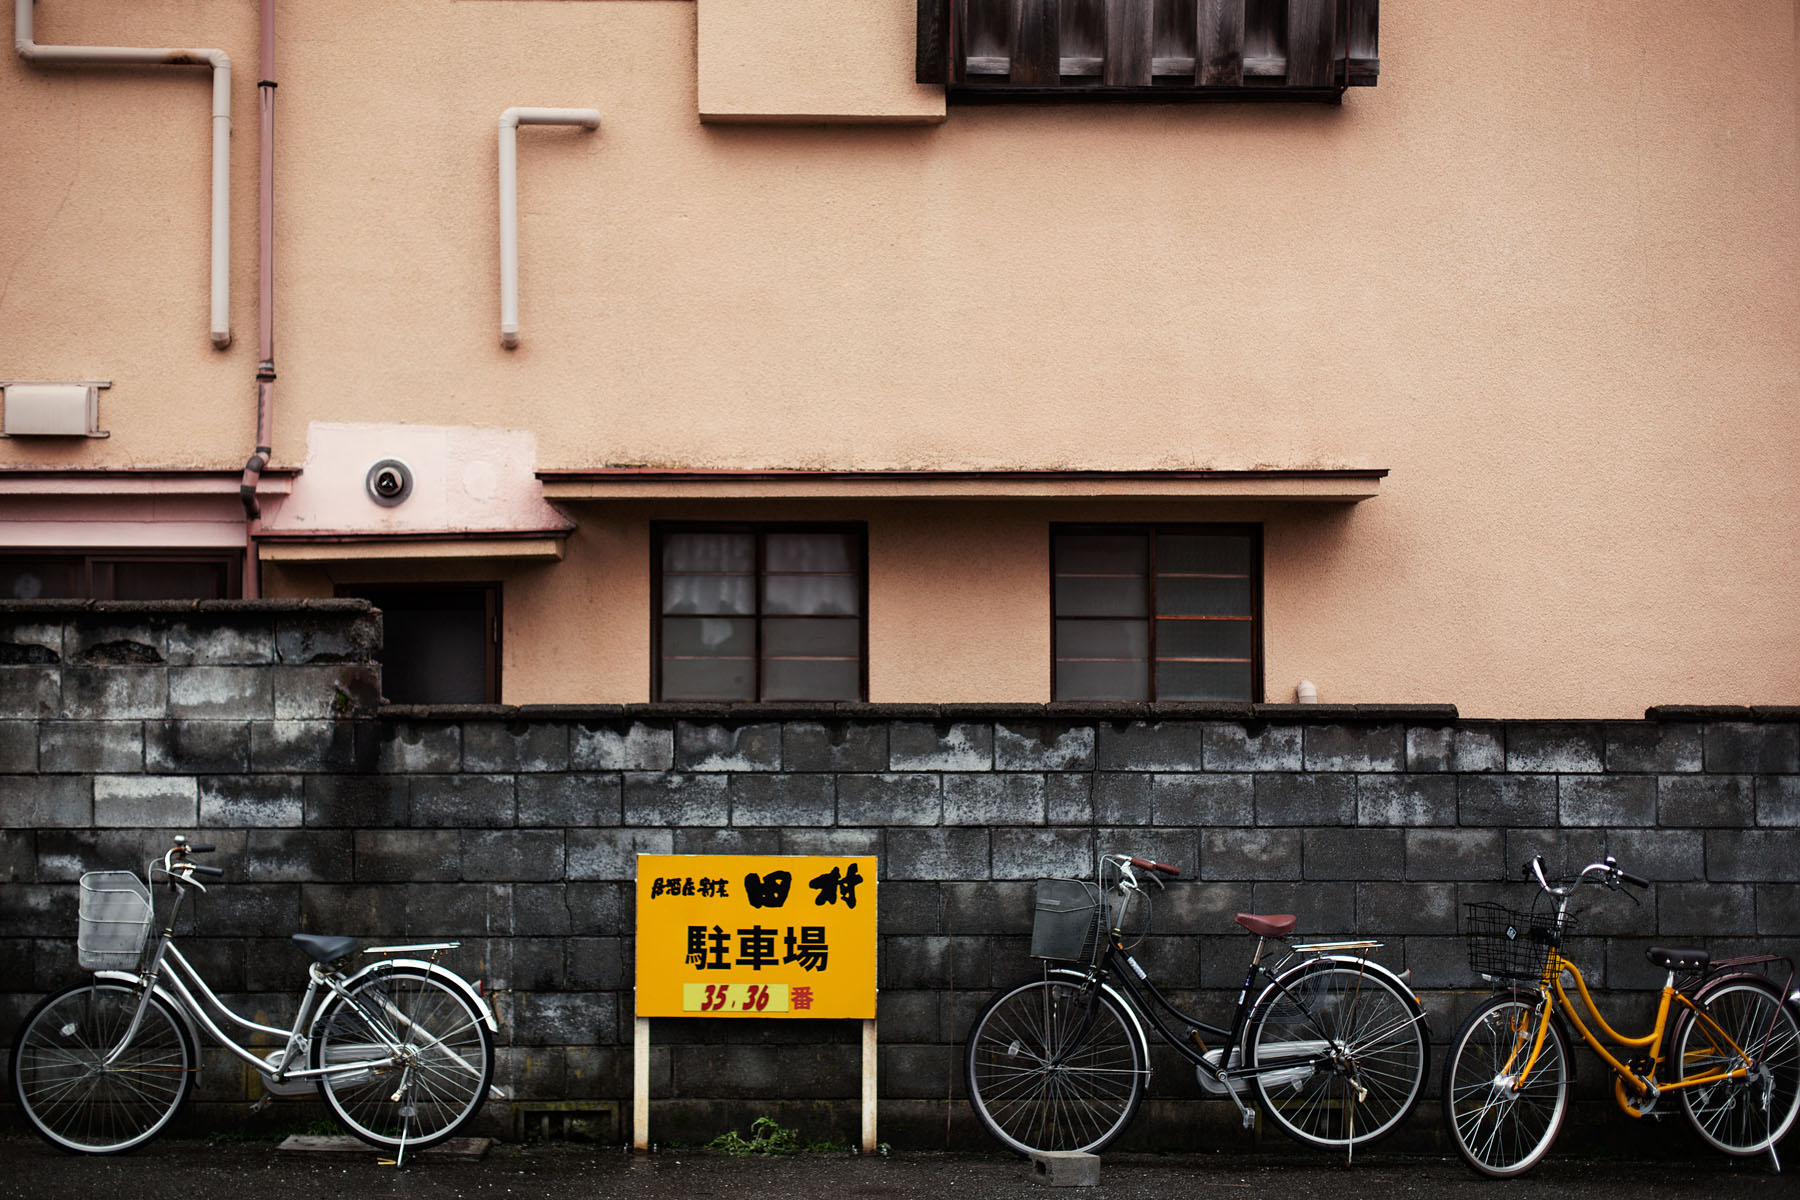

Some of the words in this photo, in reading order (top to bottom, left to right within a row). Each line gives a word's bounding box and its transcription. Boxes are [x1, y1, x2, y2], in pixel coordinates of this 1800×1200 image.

[744, 863, 863, 909] 田村
[685, 925, 829, 971] 駐車場
[791, 986, 814, 1010] 番
